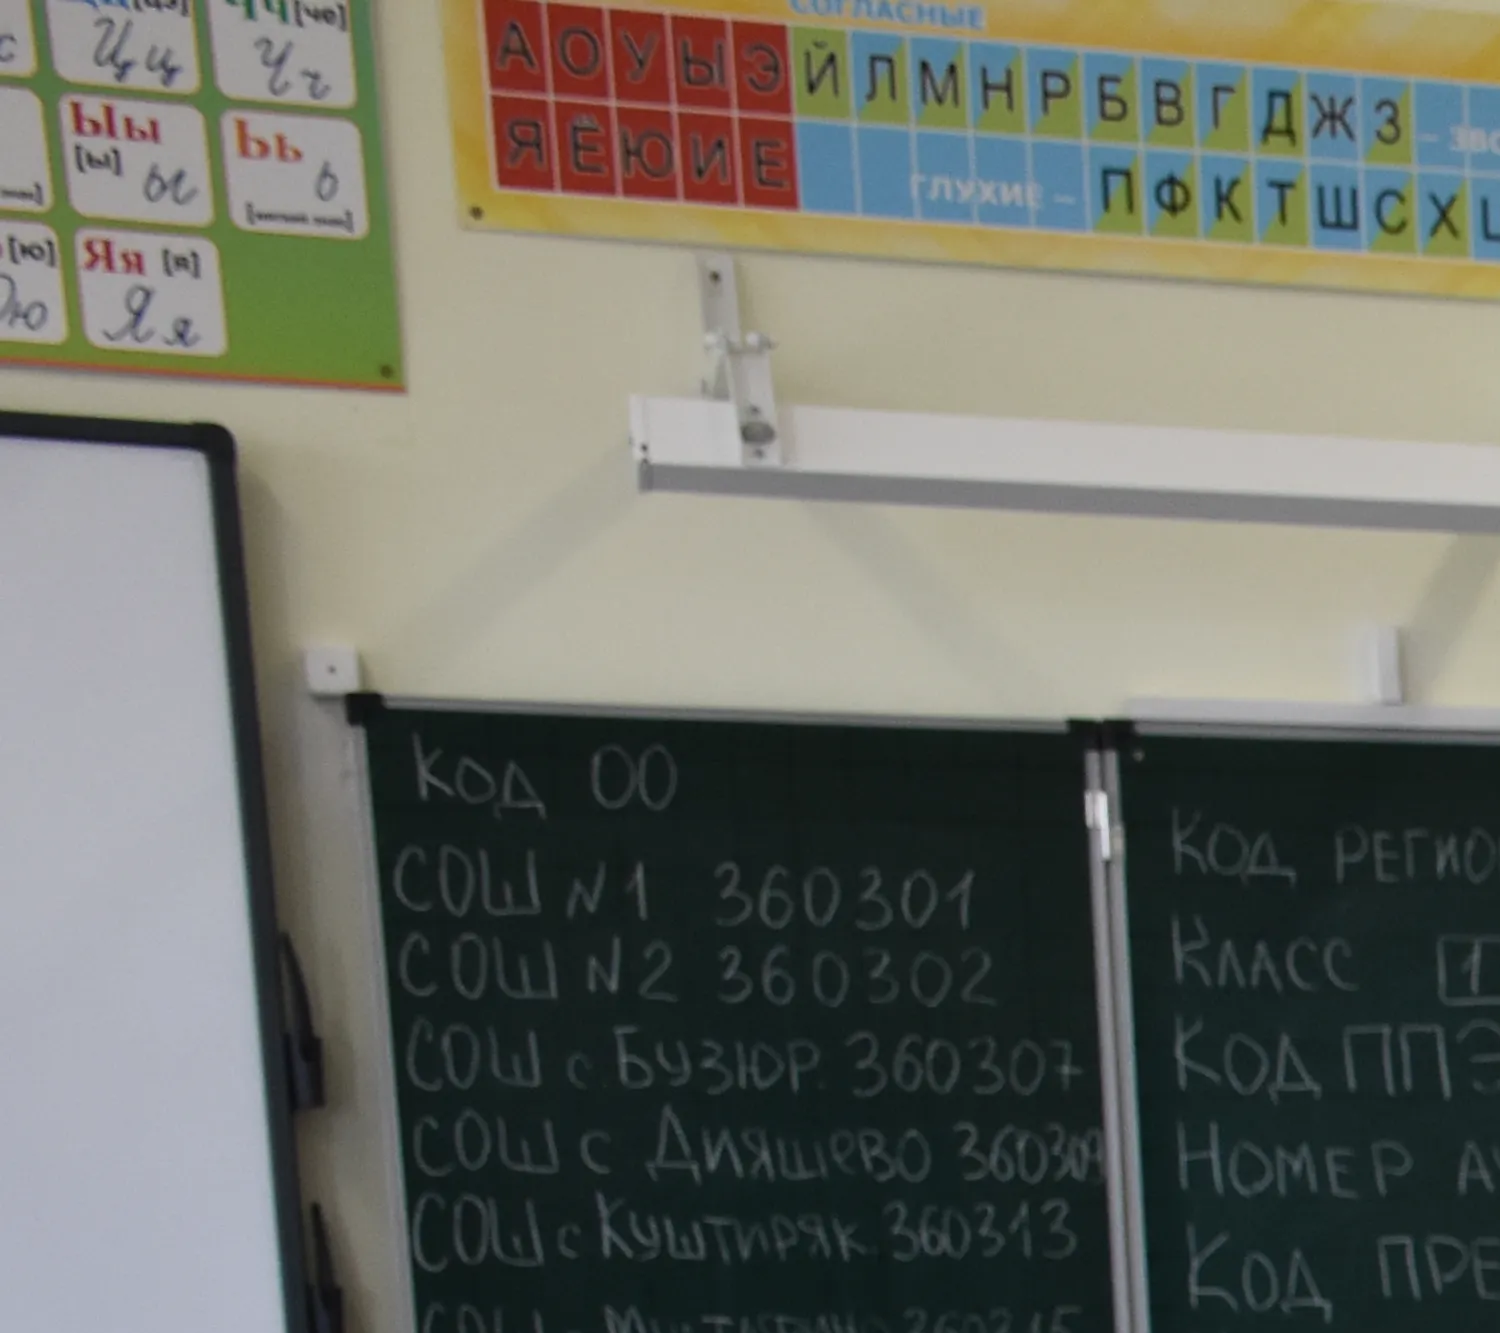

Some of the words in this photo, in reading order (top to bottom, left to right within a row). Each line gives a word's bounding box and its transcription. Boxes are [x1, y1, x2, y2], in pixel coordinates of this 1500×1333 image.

[910, 174, 1044, 210] ГЛУХИЕ
[392, 844, 542, 918] СОШ
[713, 860, 976, 932] 360301
[398, 932, 558, 1000] СОШ
[718, 944, 997, 1007] 360302
[406, 1018, 542, 1091] СОШ
[846, 1029, 1083, 1097] 360307
[413, 1109, 559, 1178] СОШ
[412, 1191, 544, 1272] СОШ
[883, 1199, 1078, 1263] 360313
